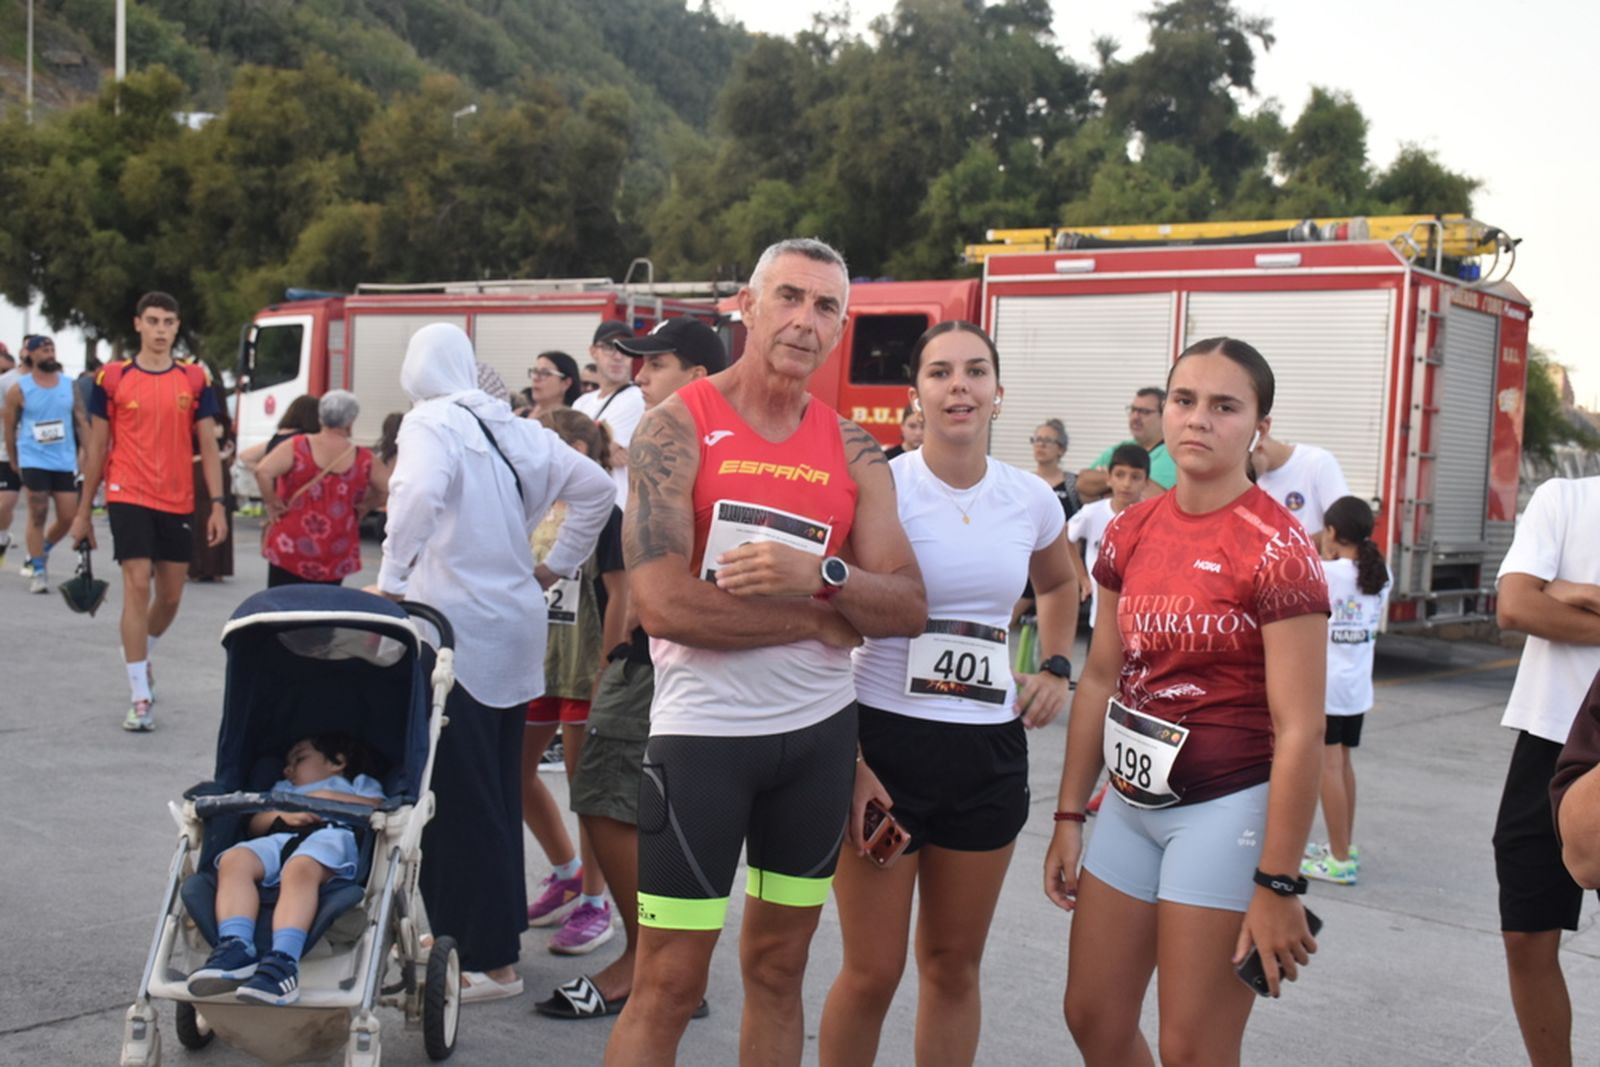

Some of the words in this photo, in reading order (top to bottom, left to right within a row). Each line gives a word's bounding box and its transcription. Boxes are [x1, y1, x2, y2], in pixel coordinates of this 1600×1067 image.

[718, 460, 830, 486] ESPAÑA
[1126, 594, 1195, 614] MEDIO
[1134, 608, 1257, 635] MARATÓN
[1141, 632, 1240, 652] SEVILLA
[933, 649, 993, 687] 401
[1114, 741, 1152, 789] 198
